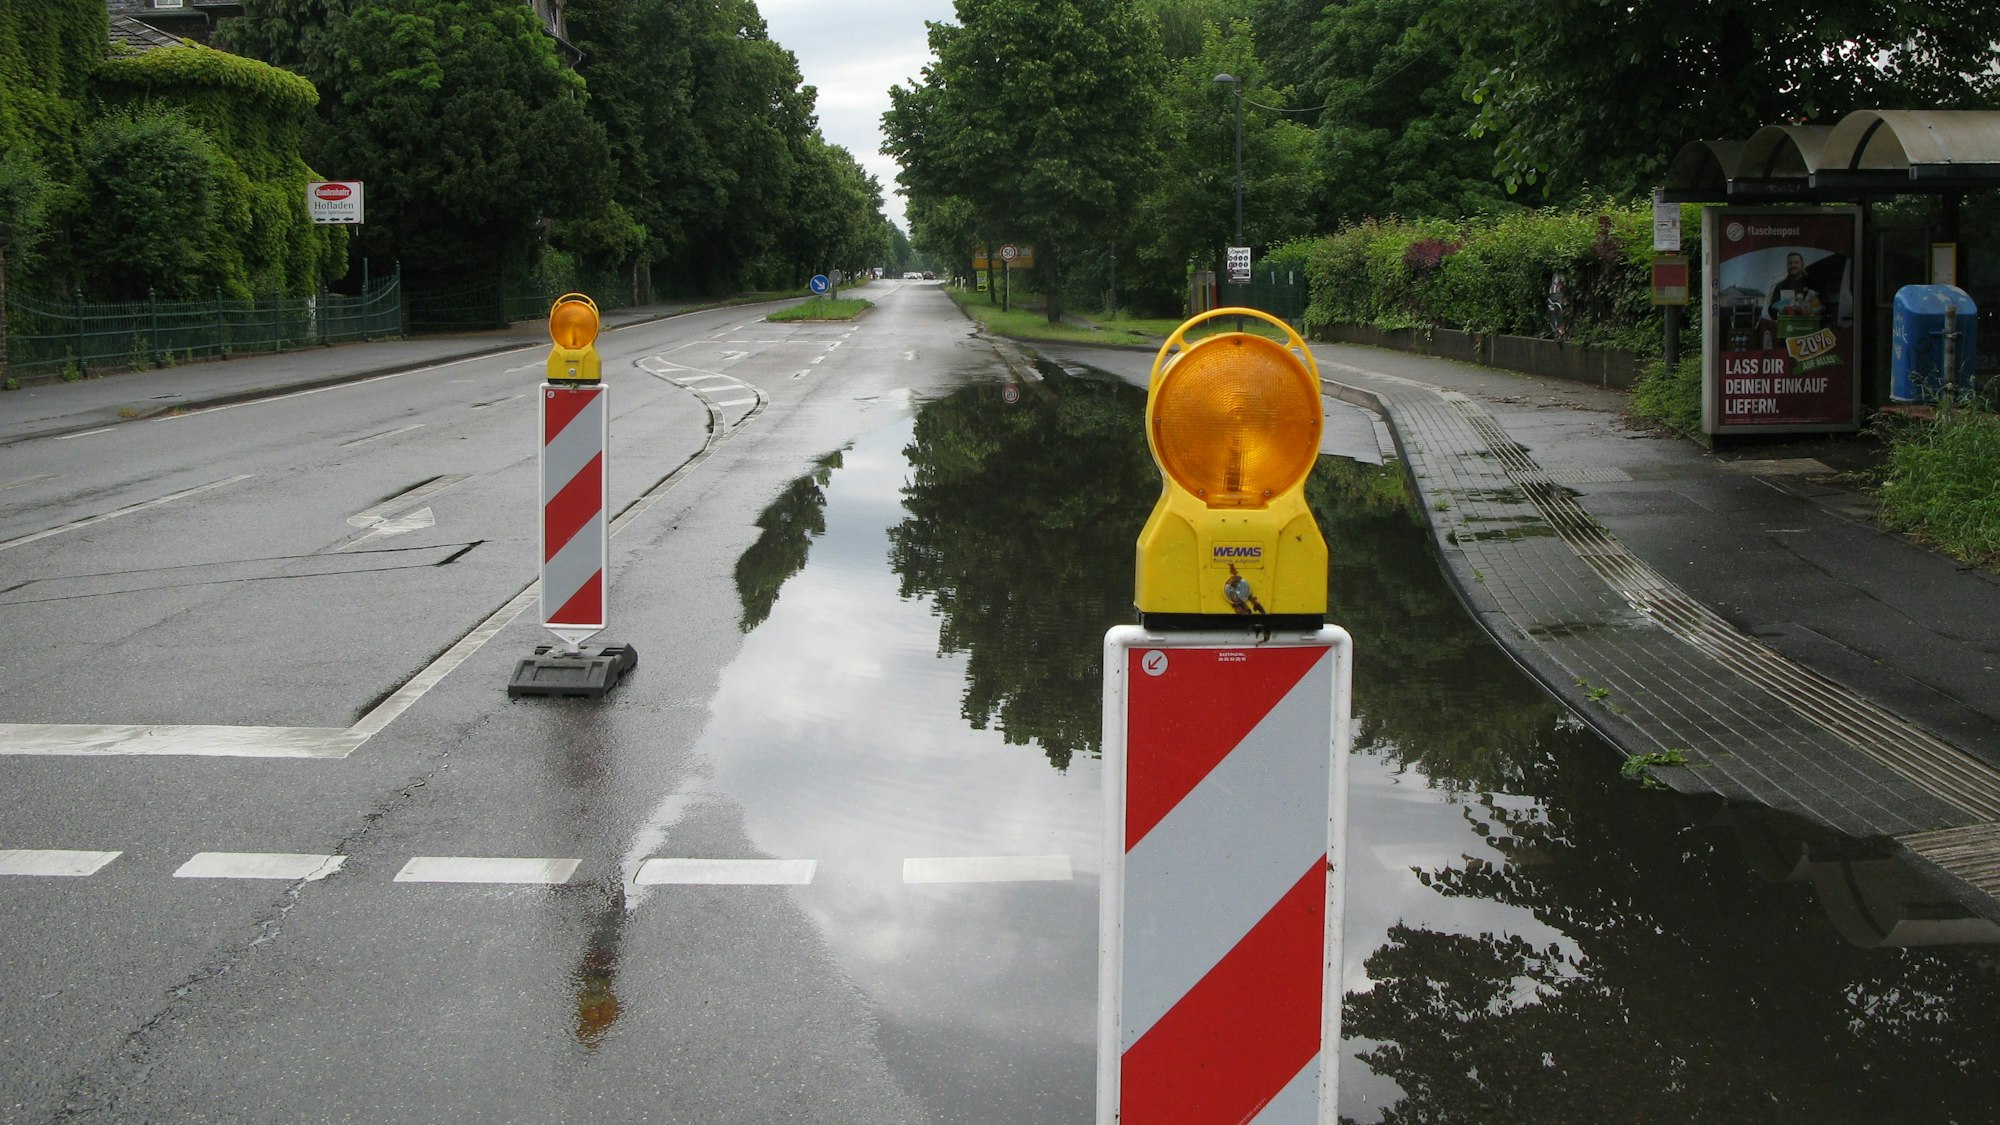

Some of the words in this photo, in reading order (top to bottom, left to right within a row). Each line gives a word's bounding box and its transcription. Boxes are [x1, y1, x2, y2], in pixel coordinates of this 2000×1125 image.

[314, 202, 354, 210] Hofladen
[1747, 226, 1800, 238] flaschenpost
[1004, 249, 1013, 257] 50
[1796, 332, 1832, 357] 20%
[1725, 359, 1759, 375] LASS
[1762, 359, 1784, 374] DIR
[1802, 359, 1816, 371] AUF
[1725, 379, 1771, 395] DEINEN
[1774, 378, 1829, 393] EINKAUF
[1725, 399, 1780, 415] LIEFERN.
[1213, 547, 1262, 557] WEMAS
